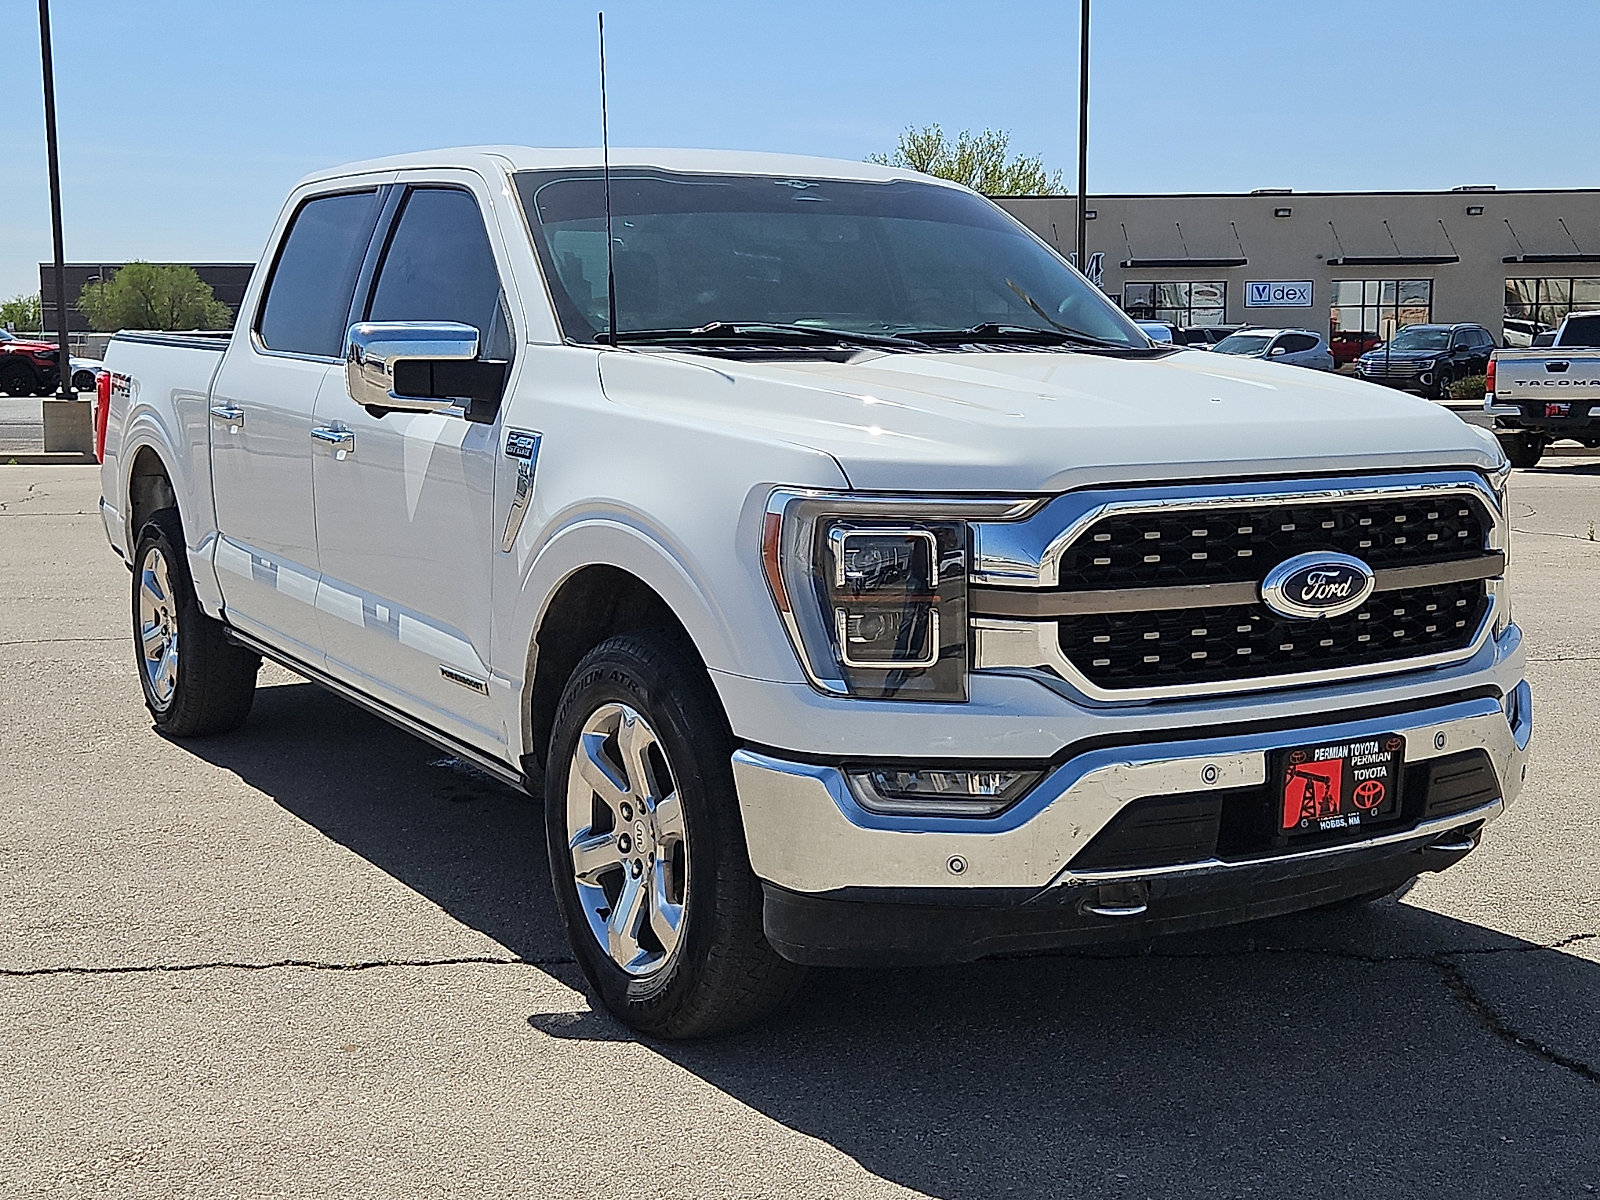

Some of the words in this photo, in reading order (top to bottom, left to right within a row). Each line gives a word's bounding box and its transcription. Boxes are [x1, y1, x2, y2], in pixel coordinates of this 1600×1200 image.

[1514, 379, 1600, 388] TACOMA
[1301, 570, 1353, 601] Ford
[1313, 744, 1348, 762] PERMIAN
[1350, 741, 1379, 757] TOYOTA
[1351, 752, 1391, 767] PERMIAN
[1353, 766, 1388, 781] TOYOTA
[1348, 815, 1361, 826] NM
